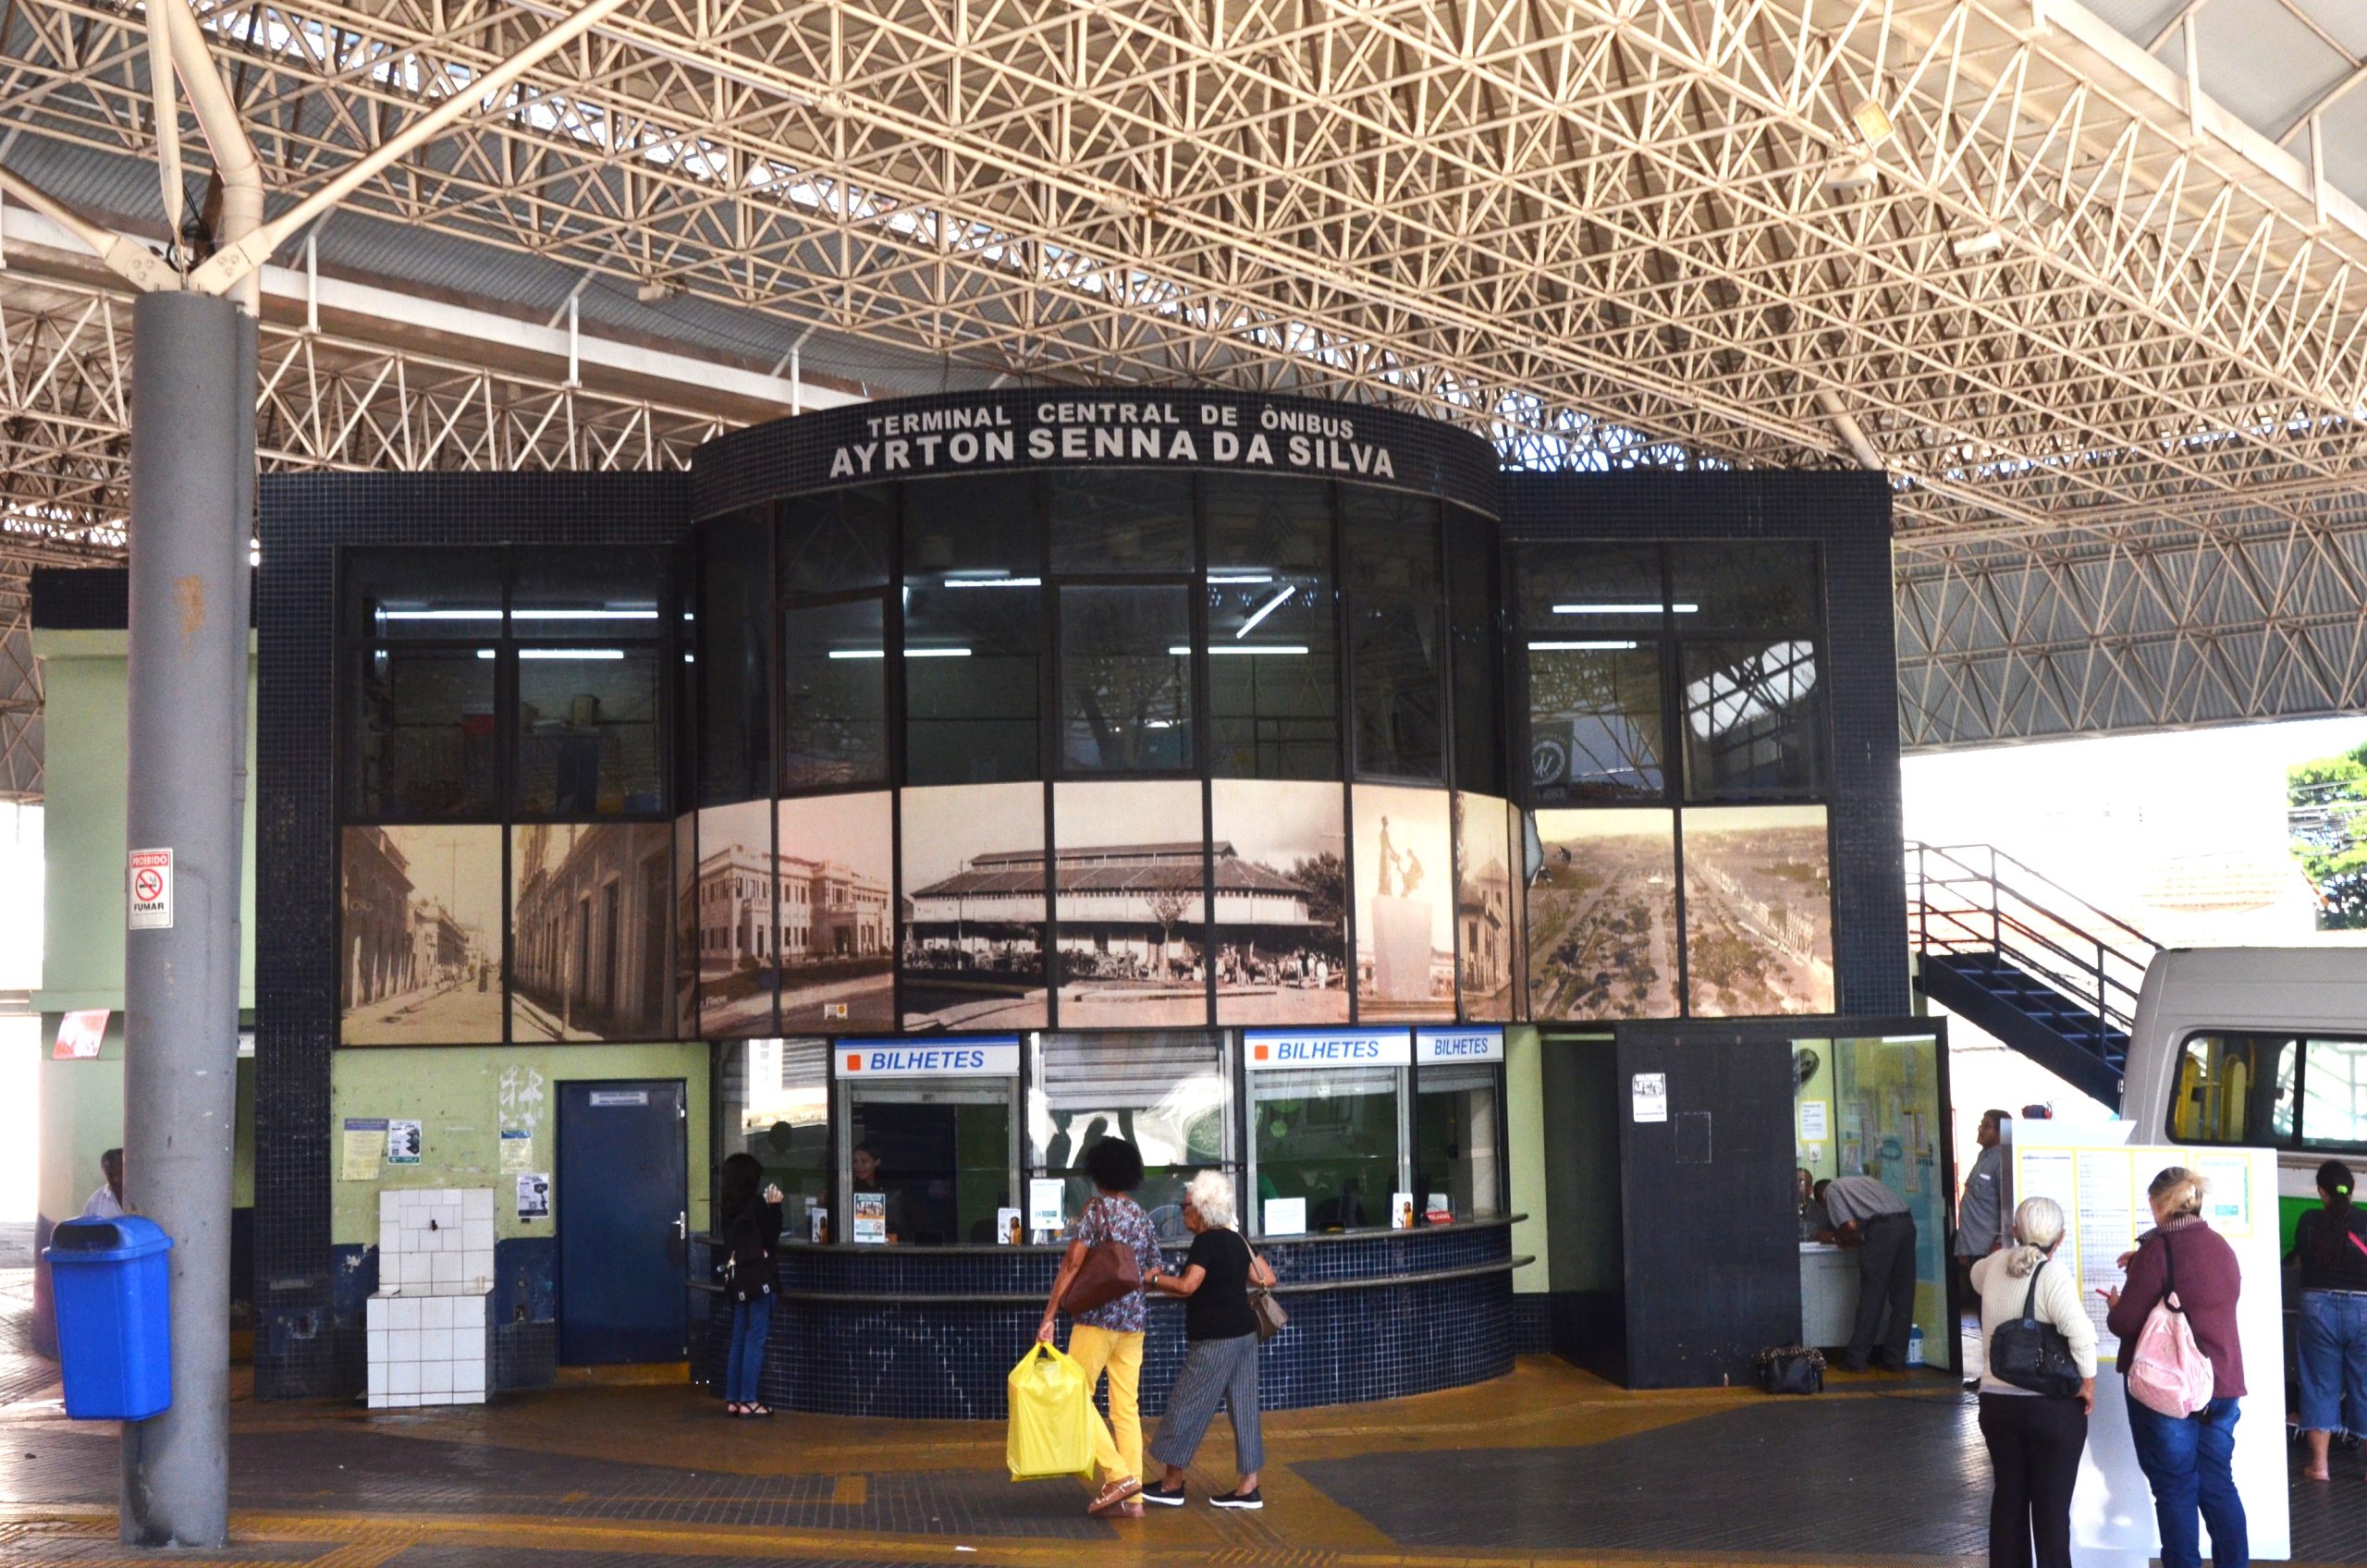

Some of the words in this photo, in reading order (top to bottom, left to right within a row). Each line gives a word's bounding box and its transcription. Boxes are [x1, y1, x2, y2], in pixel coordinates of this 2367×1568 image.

[867, 405, 1012, 439] TERMINAL
[1037, 402, 1180, 423] CENTRAL
[1201, 404, 1238, 426] DE
[1260, 403, 1354, 440] ÔNIBUS
[829, 430, 1013, 479] AYRTON
[1027, 427, 1198, 460] SENNA
[1213, 431, 1274, 465] DA
[1288, 435, 1394, 479] SILVA
[132, 854, 167, 866] PROIBIDO
[133, 902, 165, 912] FUMAR
[1278, 1041, 1379, 1060] BILHETES
[1434, 1037, 1489, 1056] BILHETES
[870, 1050, 985, 1070] BILHETES
